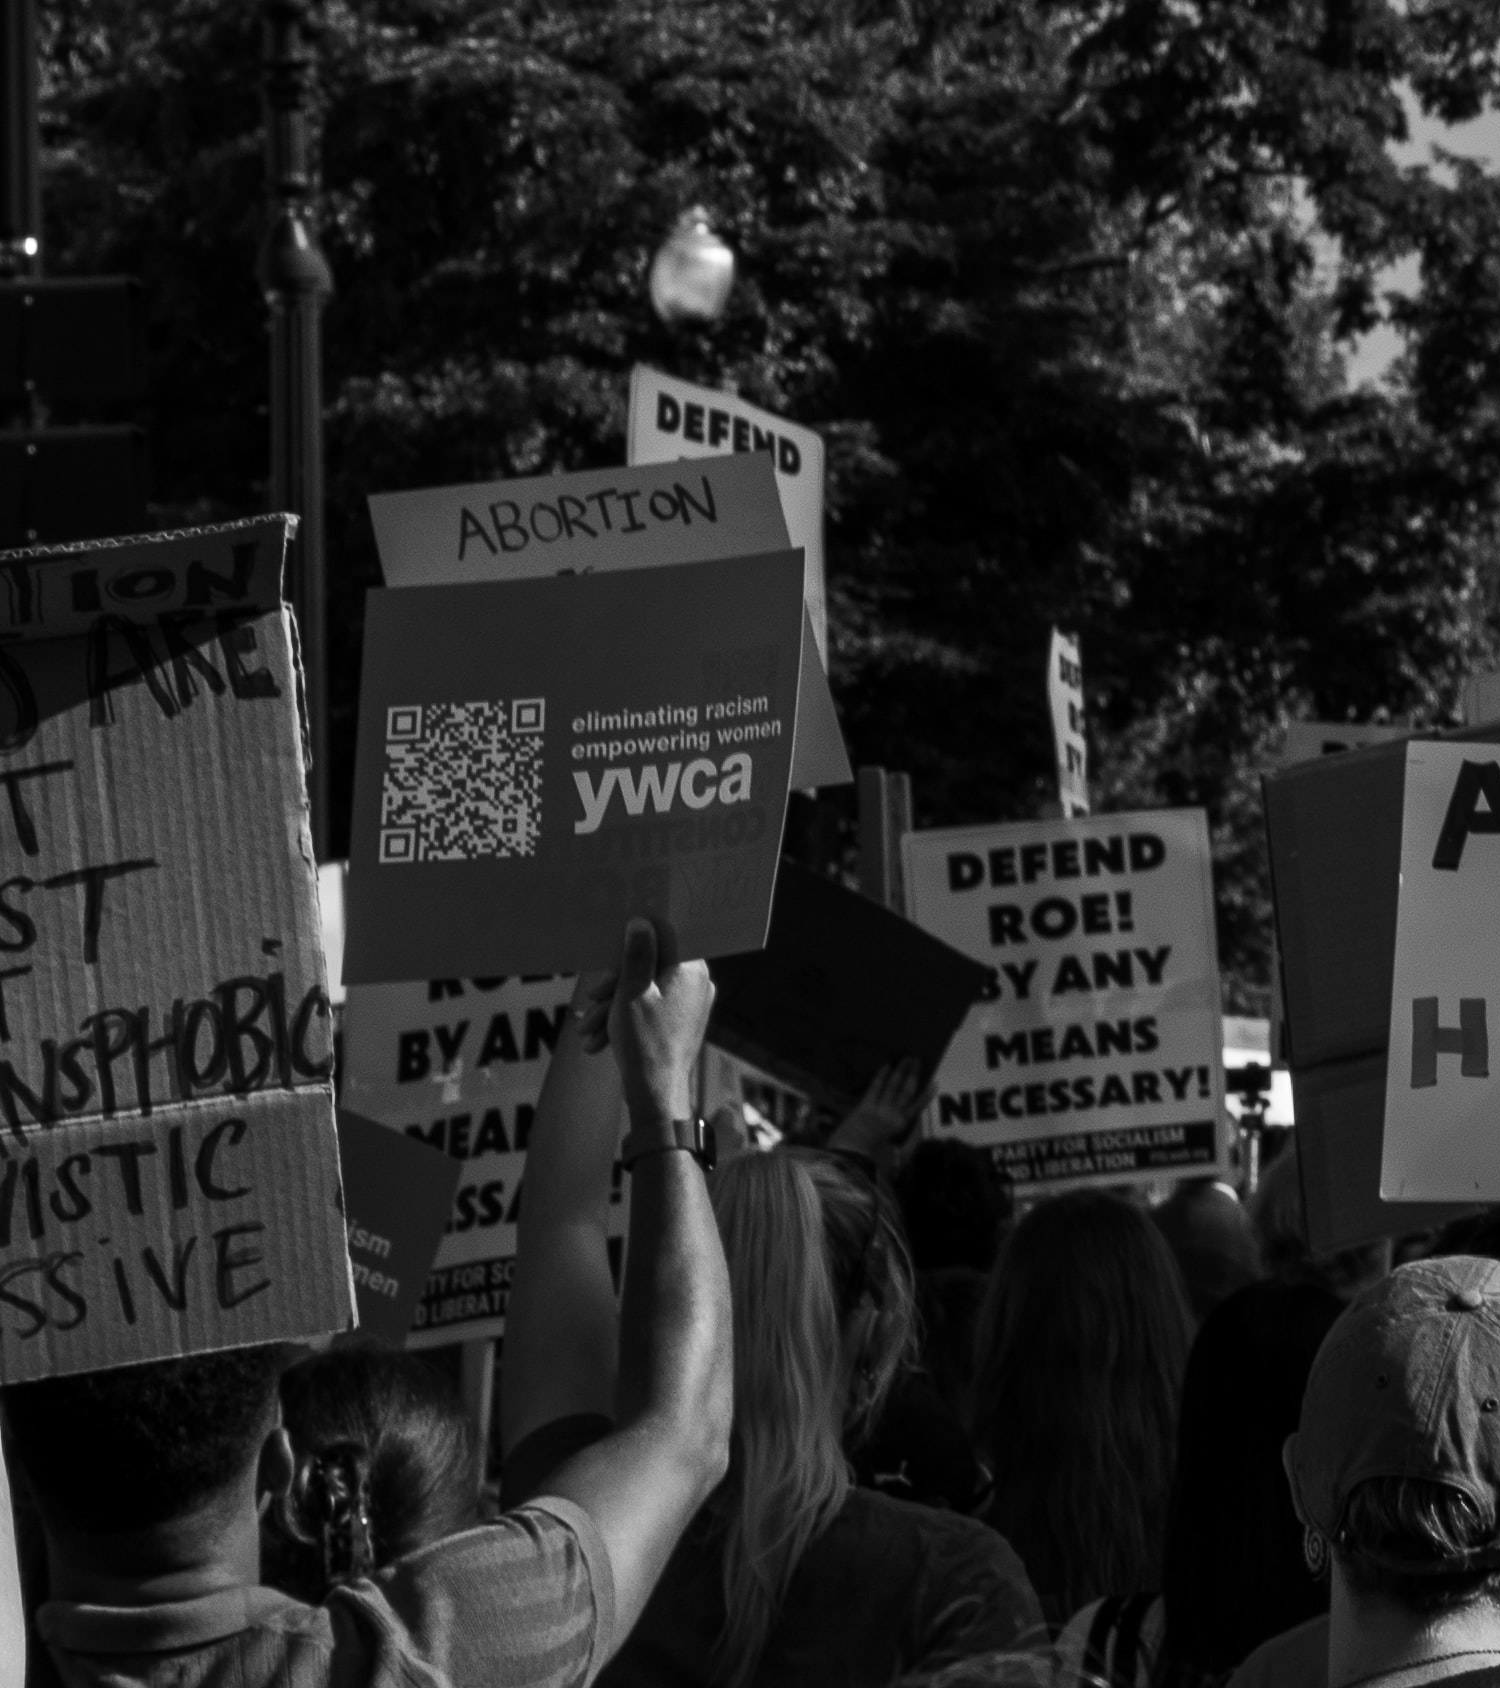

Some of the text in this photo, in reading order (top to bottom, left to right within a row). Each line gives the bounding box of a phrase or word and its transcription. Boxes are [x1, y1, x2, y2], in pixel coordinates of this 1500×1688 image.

[656, 390, 801, 476] DEFEND
[457, 475, 718, 561] ABORTION
[86, 604, 282, 727] ARE
[570, 717, 783, 761] empowering women
[571, 694, 769, 734] eliminating racism
[571, 751, 754, 835] ywca
[947, 834, 1166, 893] DEFEND
[989, 891, 1135, 947] ROE!
[1052, 945, 1172, 997] ANY
[397, 1005, 570, 1084] BY AN
[985, 1016, 1160, 1070] MEANS
[938, 1066, 1211, 1126] NECESSARY!
[1052, 1134, 1089, 1156] FOR
[1091, 1125, 1188, 1151] SOCIALISM
